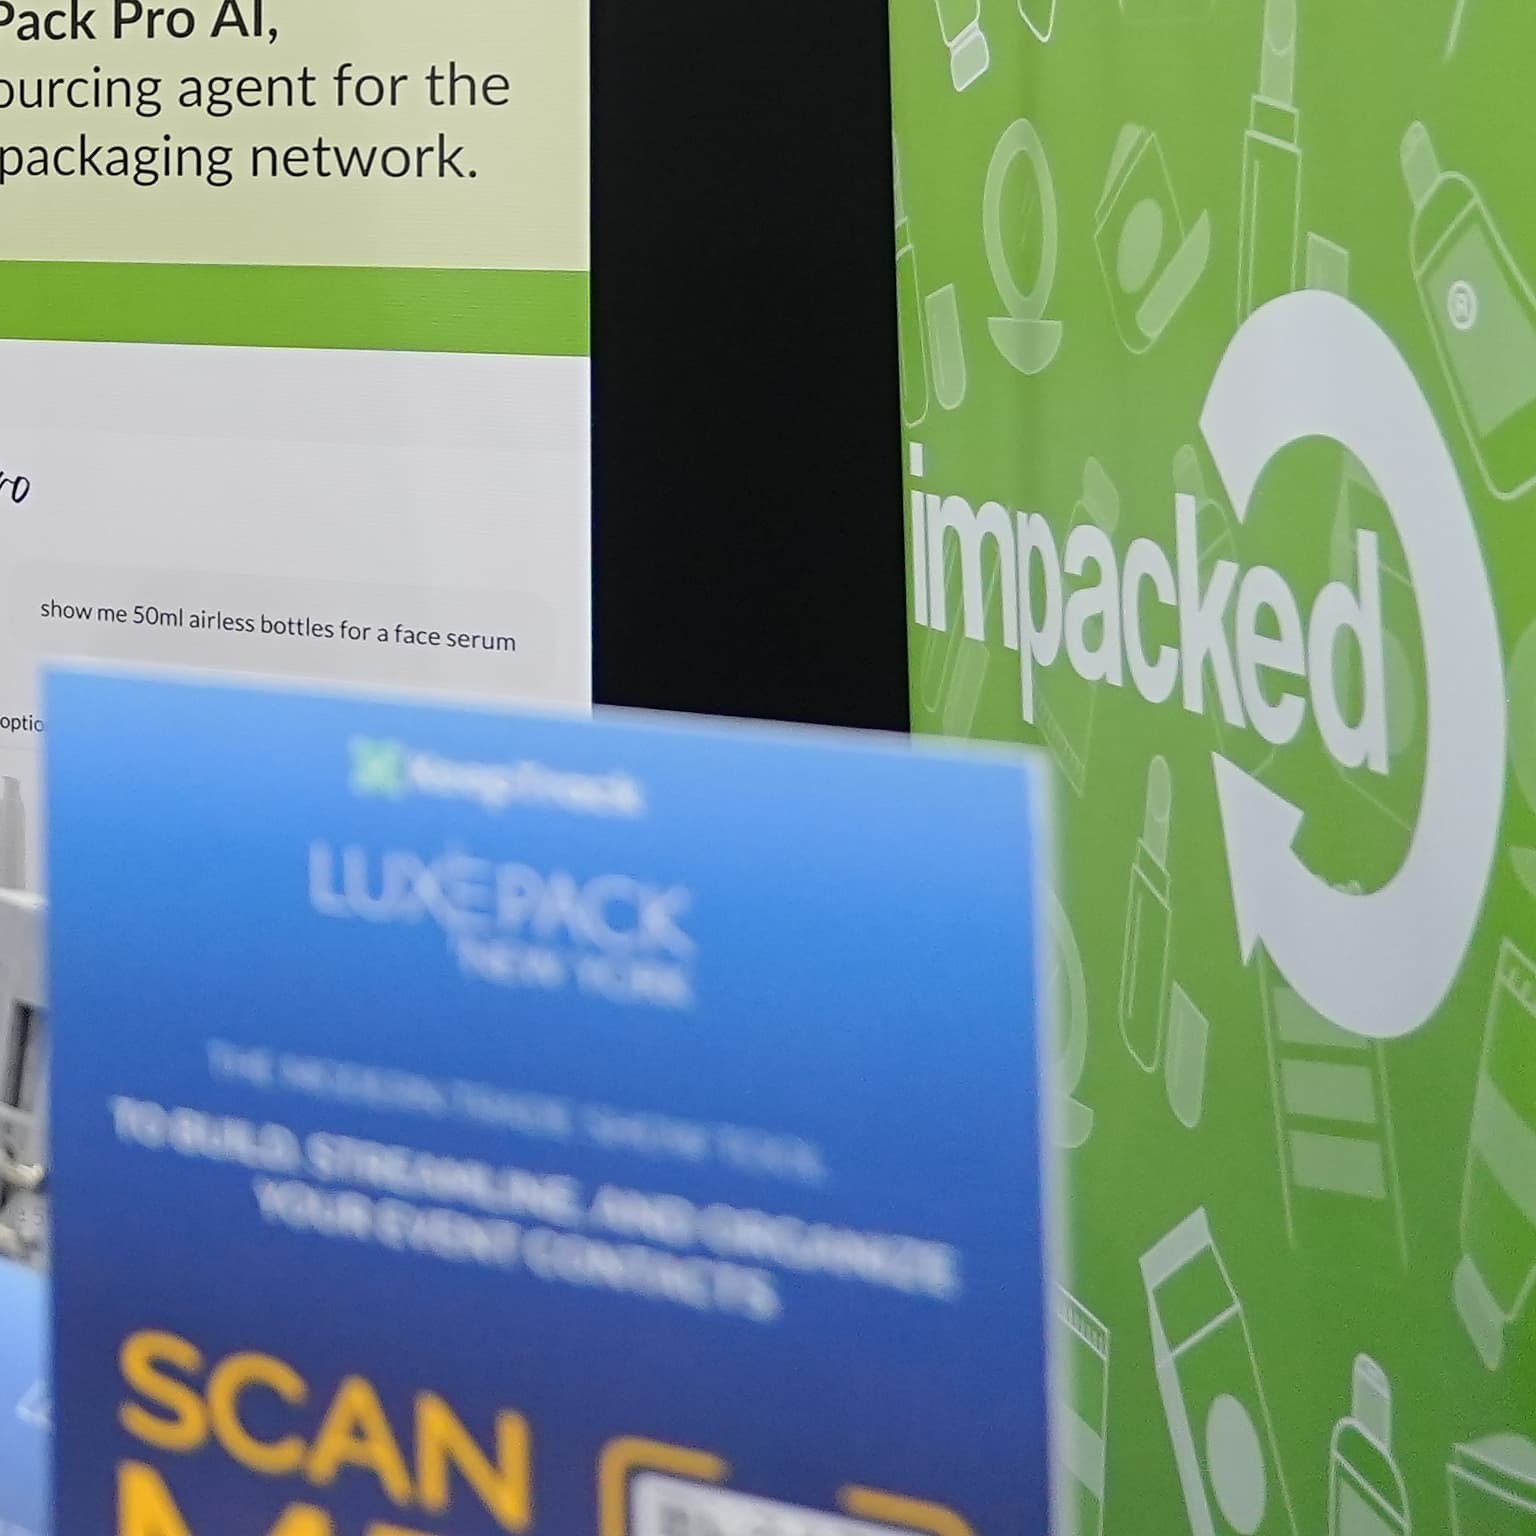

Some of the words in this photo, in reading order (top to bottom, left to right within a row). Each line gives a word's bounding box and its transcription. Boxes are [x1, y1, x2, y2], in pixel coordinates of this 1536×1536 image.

[177, 68, 316, 116] agent
[333, 64, 402, 109] for
[425, 62, 510, 106] the
[249, 136, 477, 180] network.
[40, 599, 93, 621] show
[97, 607, 128, 623] me
[133, 605, 184, 628] 50ml
[189, 608, 255, 633] airless
[260, 614, 334, 640] bottles
[340, 620, 371, 642] for
[376, 627, 389, 643] a
[394, 623, 440, 647] face
[446, 631, 516, 653] serum
[908, 442, 1389, 777] impacked
[119, 1328, 532, 1534] SCAN
